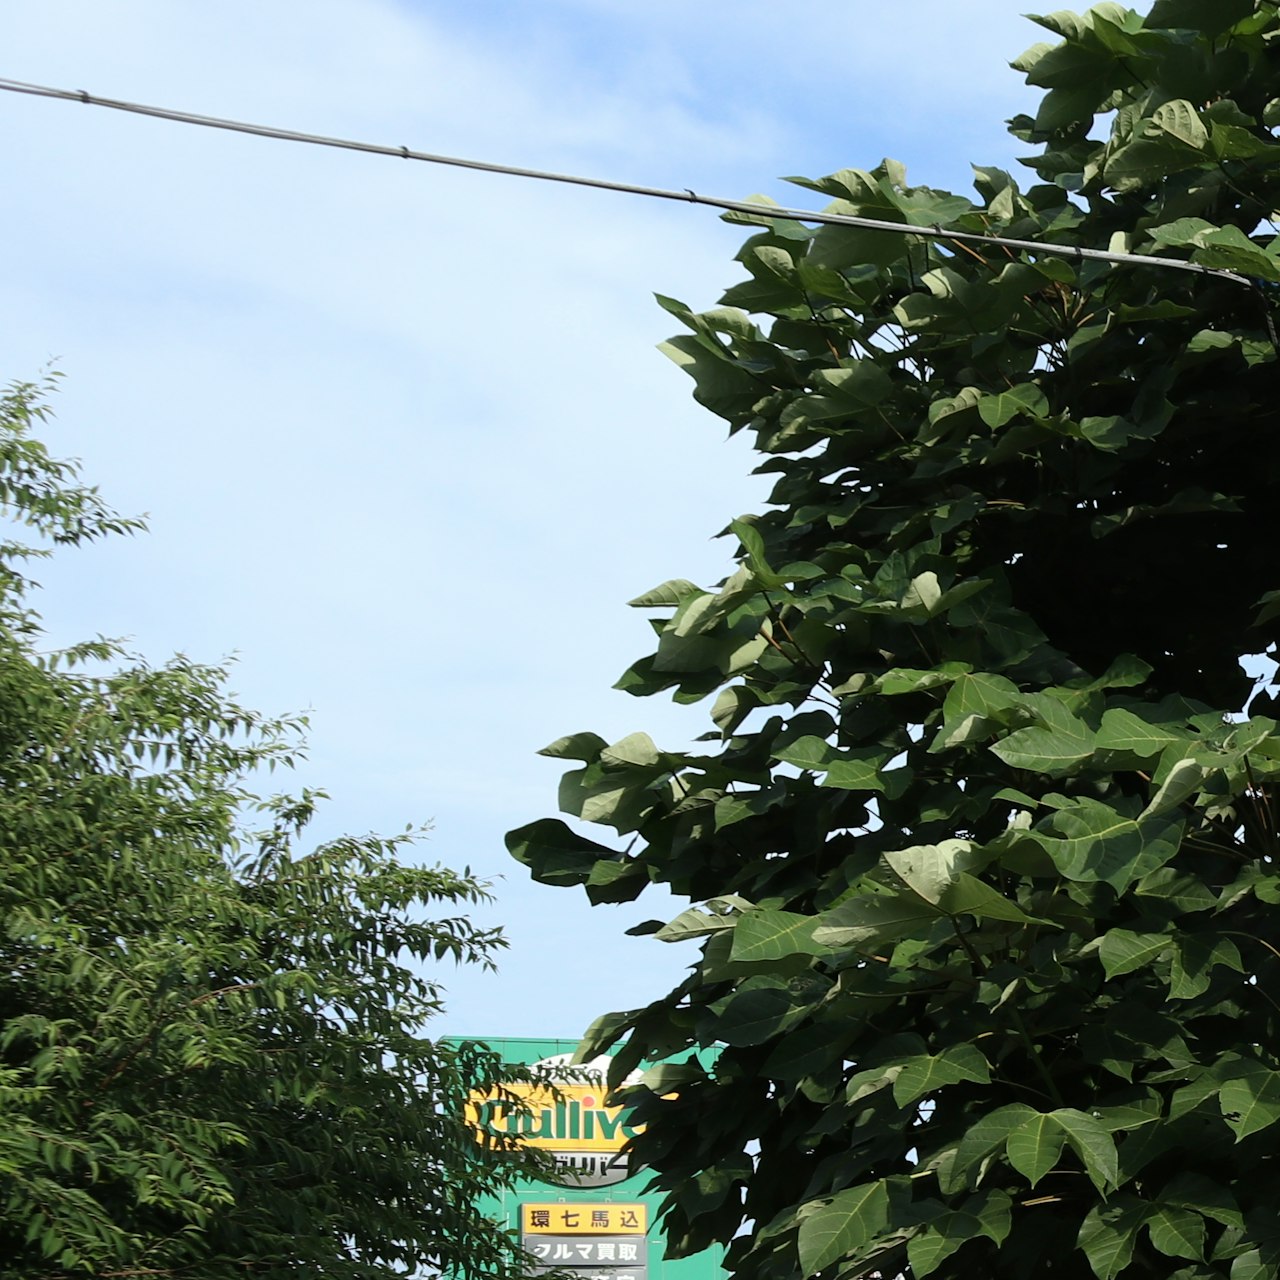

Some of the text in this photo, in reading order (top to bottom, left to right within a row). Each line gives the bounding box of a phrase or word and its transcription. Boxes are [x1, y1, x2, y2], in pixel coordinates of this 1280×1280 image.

[479, 1095, 647, 1141] Gullive
[530, 1209, 639, 1229] 環七馬込
[533, 1243, 638, 1261] クルマ買取
